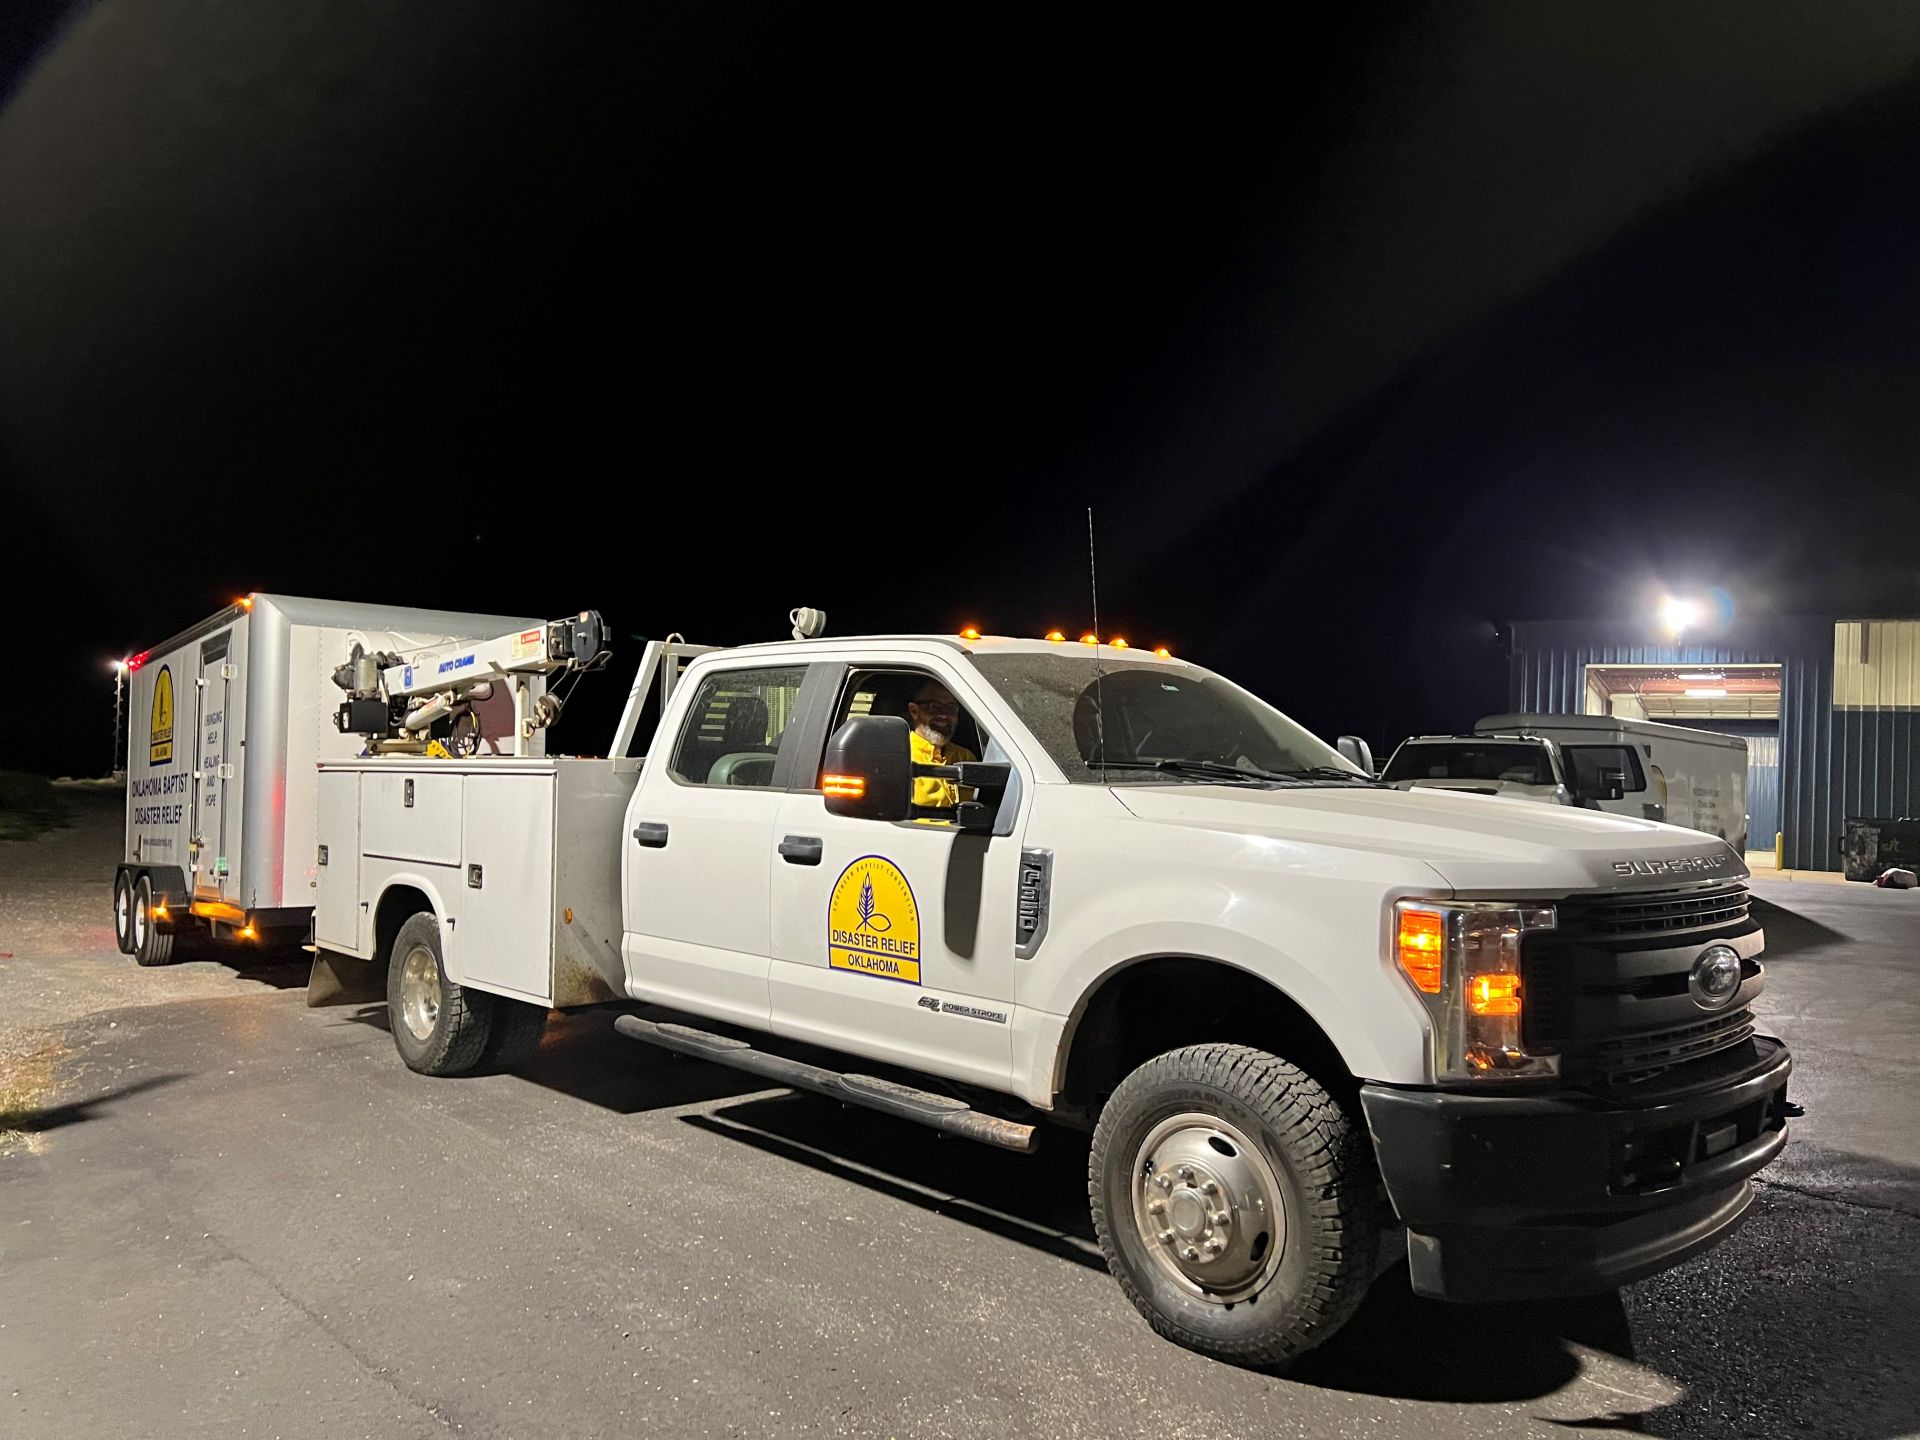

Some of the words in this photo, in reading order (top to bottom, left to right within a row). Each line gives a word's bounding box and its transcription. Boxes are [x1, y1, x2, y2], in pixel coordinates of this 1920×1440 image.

[438, 660, 453, 674] AUTO
[454, 654, 475, 669] CRANE
[204, 755, 220, 769] HEALING
[132, 777, 162, 798] OKLAHOMA
[163, 773, 188, 794] BAPTIST
[206, 775, 215, 787] AND
[205, 794, 217, 807] HOPE
[135, 806, 161, 825] DISASTER
[161, 804, 183, 825] RELIEF
[856, 862, 884, 873] BAPTIST
[886, 868, 914, 922] CONVENTION
[832, 929, 879, 949] DISASTER
[881, 937, 916, 955] RELIEF
[847, 953, 900, 974] OKLAHOMA
[943, 1002, 970, 1014] POWER
[971, 1008, 1004, 1020] STROKE
